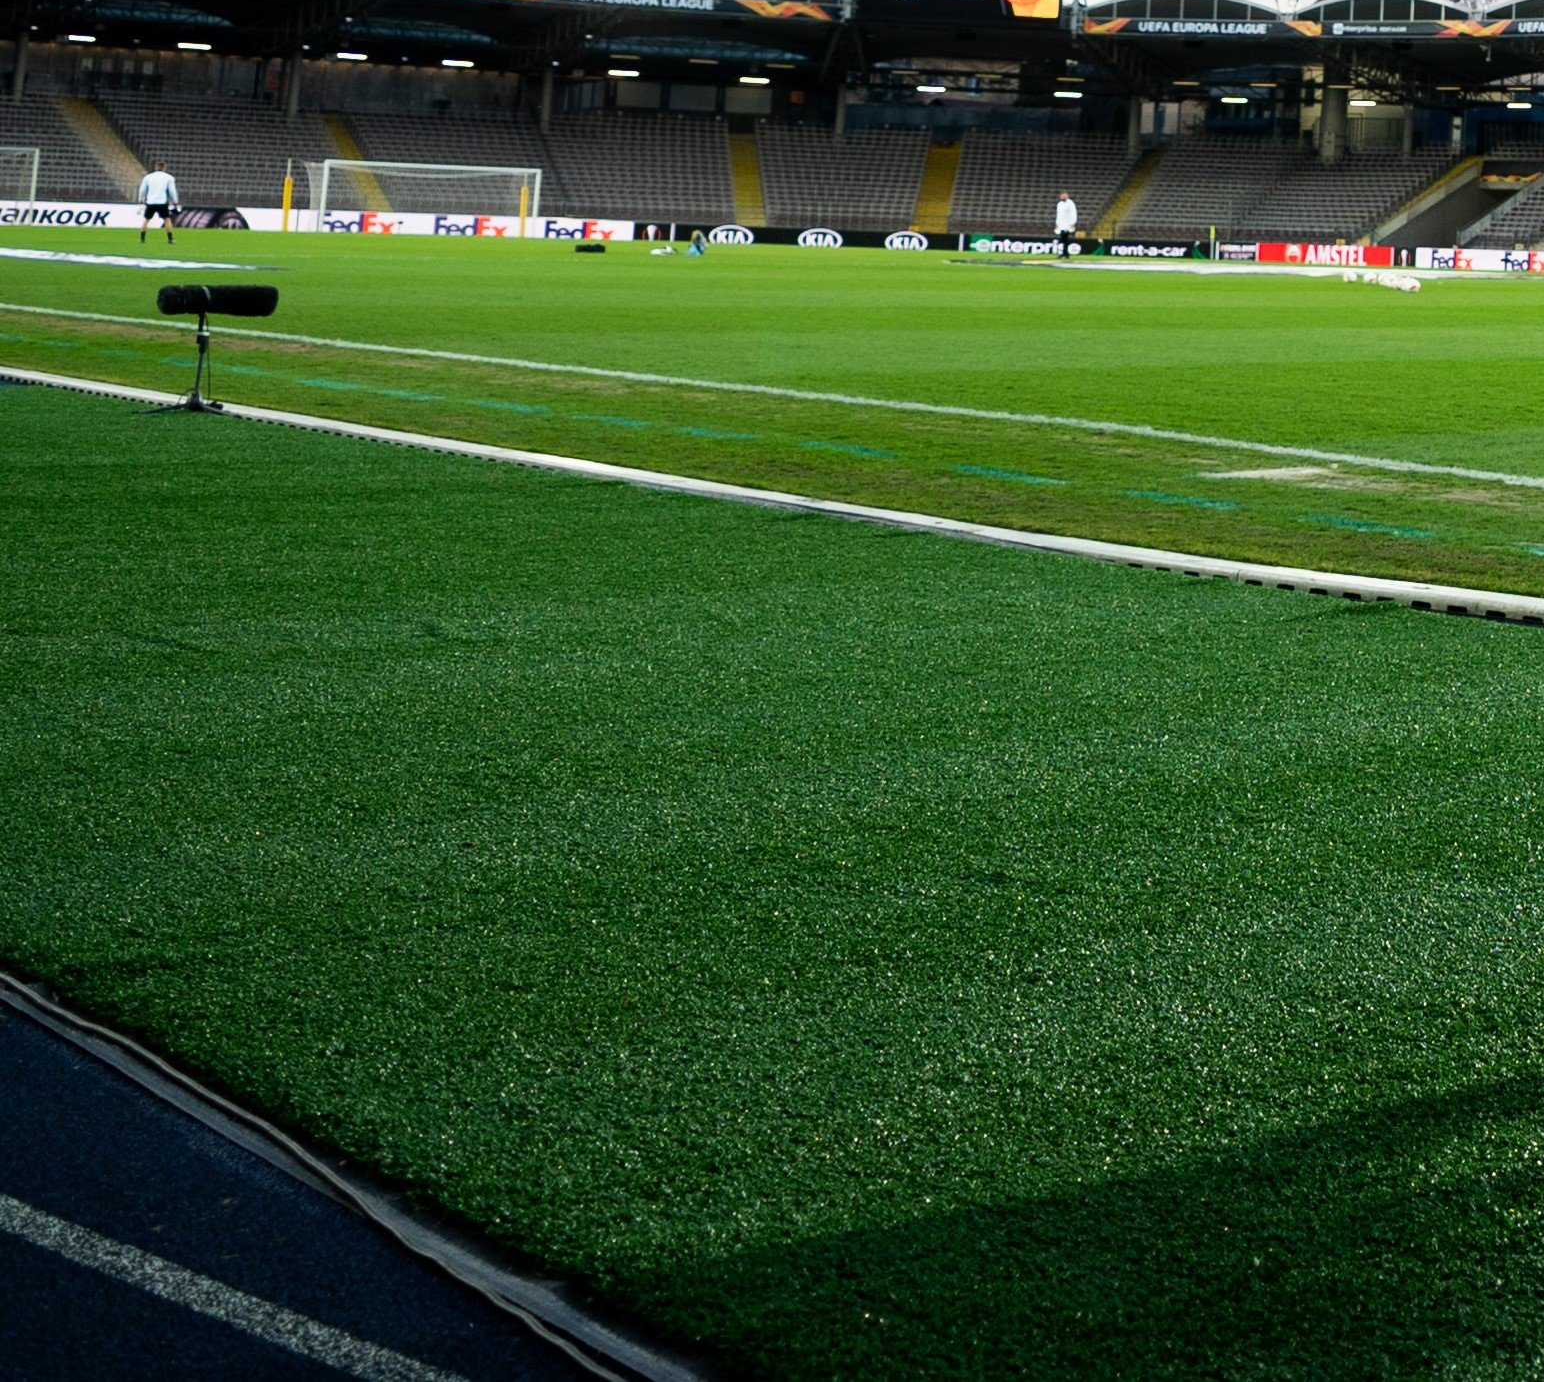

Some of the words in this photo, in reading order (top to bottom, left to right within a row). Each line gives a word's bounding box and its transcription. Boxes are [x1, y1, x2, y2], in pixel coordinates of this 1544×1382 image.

[1138, 21, 1170, 32] UEFA
[1172, 22, 1218, 33] EUROPA
[1220, 23, 1267, 34] LEAGUE
[1518, 21, 1544, 32] UEFA
[434, 214, 507, 237] FedEx
[544, 220, 614, 241] FedEx
[1111, 244, 1187, 257] rent-a-car
[1304, 244, 1370, 265] AMSTEL
[1431, 249, 1473, 270] FedEx
